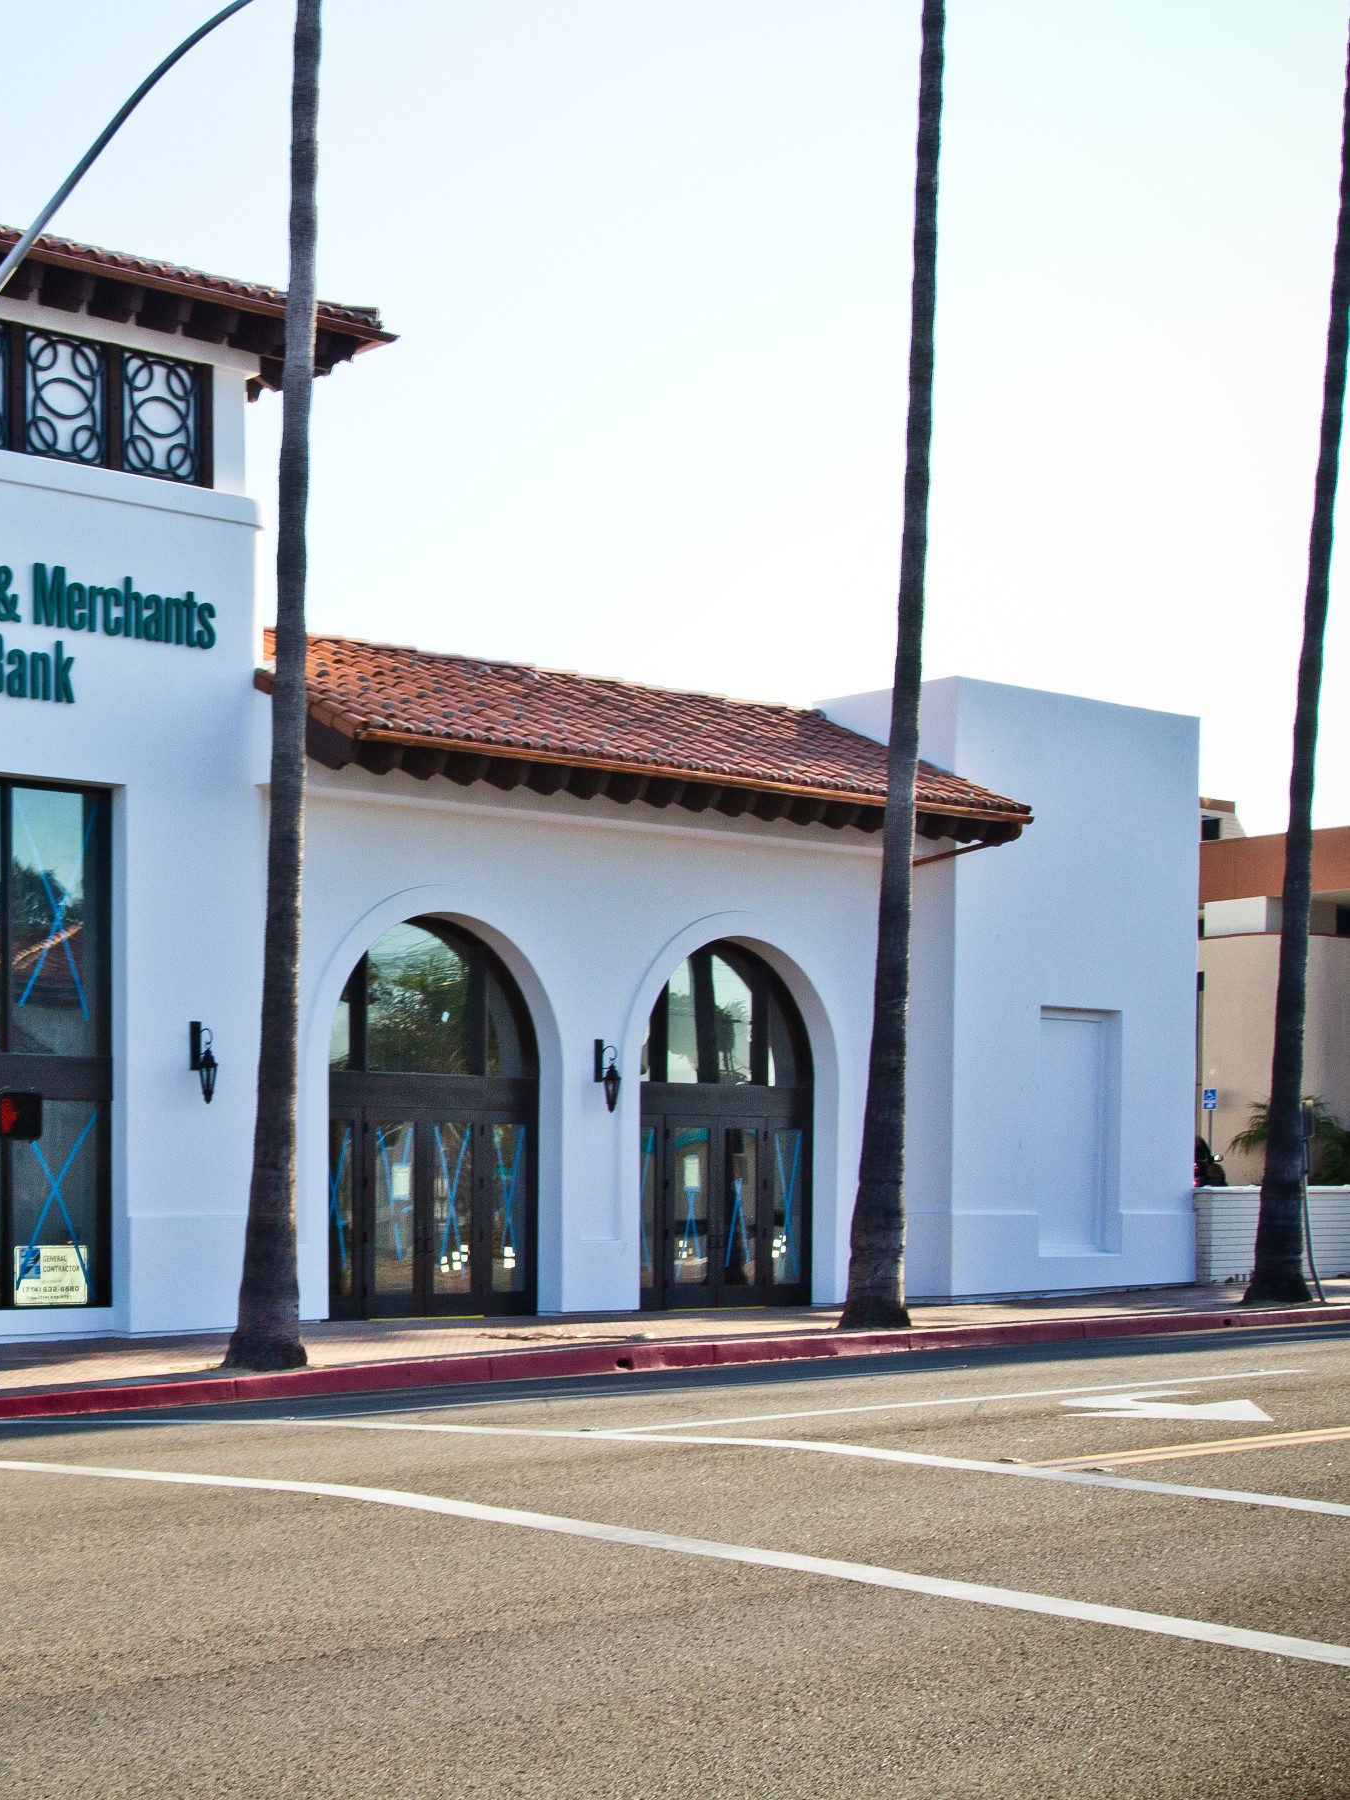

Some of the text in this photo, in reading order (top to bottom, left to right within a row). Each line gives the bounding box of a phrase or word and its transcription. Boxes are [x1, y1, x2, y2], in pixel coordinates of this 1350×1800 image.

[33, 562, 216, 649] Merchants
[43, 1255, 67, 1263] GENERAL
[43, 1265, 80, 1273] CONTRACTOR
